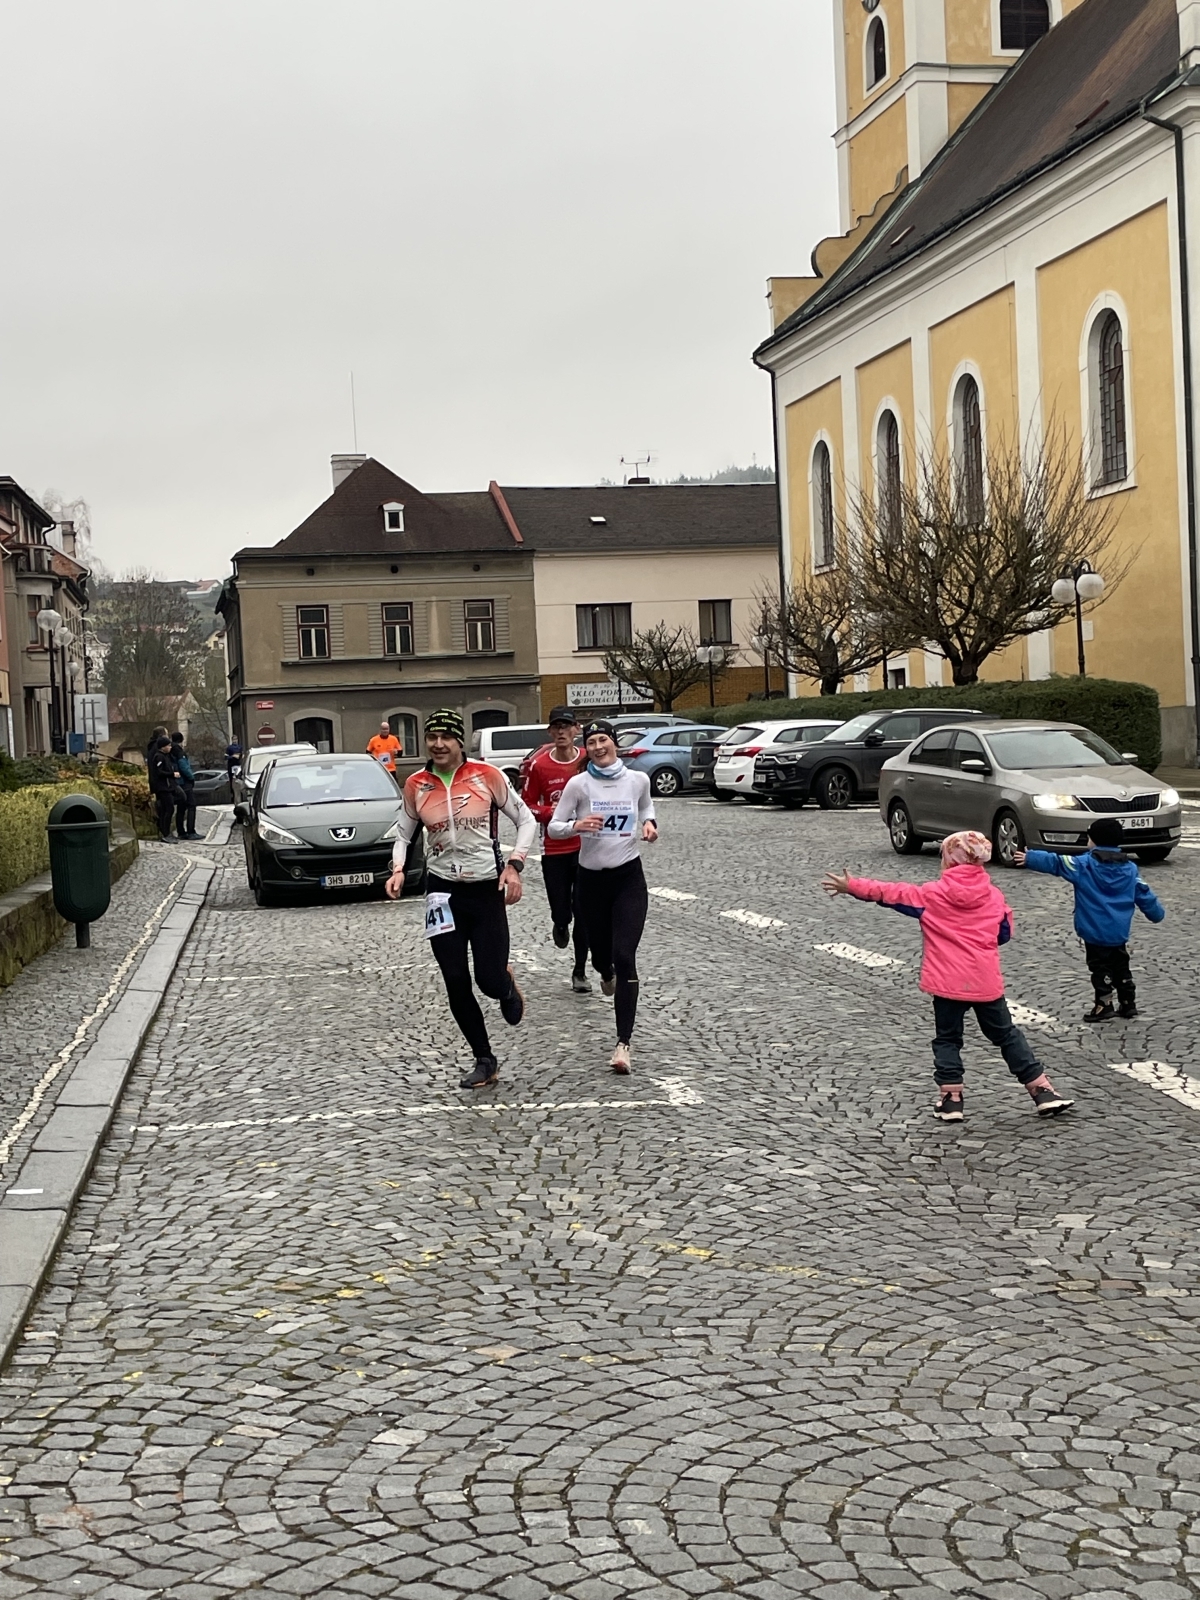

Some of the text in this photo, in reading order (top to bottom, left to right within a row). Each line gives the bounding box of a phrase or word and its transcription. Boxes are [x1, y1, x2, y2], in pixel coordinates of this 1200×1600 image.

[571, 690, 595, 698] SKLO
[603, 814, 629, 831] 47
[1131, 818, 1150, 827] 8481
[327, 874, 370, 886] 3H9 8210
